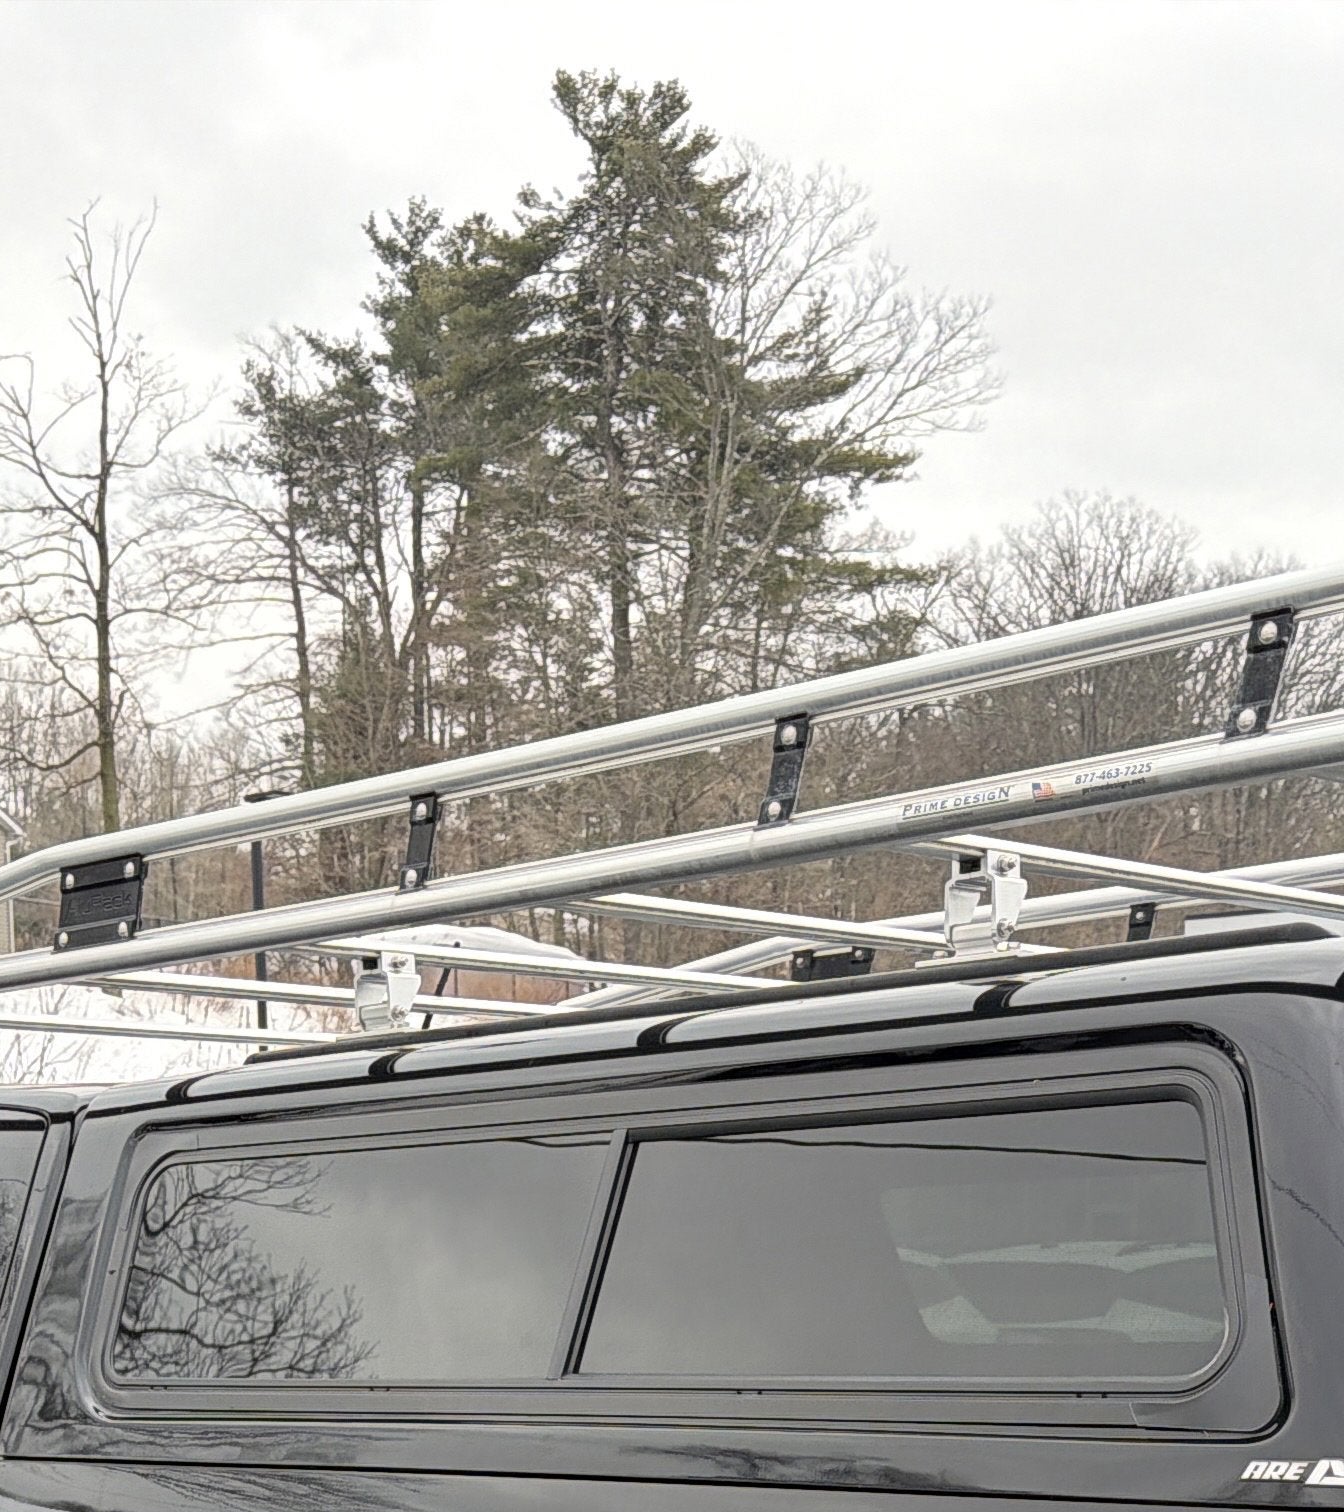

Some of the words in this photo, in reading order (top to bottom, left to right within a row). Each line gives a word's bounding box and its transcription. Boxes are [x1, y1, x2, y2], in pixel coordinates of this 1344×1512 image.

[1074, 761, 1152, 785] 877-463-7225
[902, 799, 948, 817] PRIME
[953, 785, 1010, 807] DESIGN
